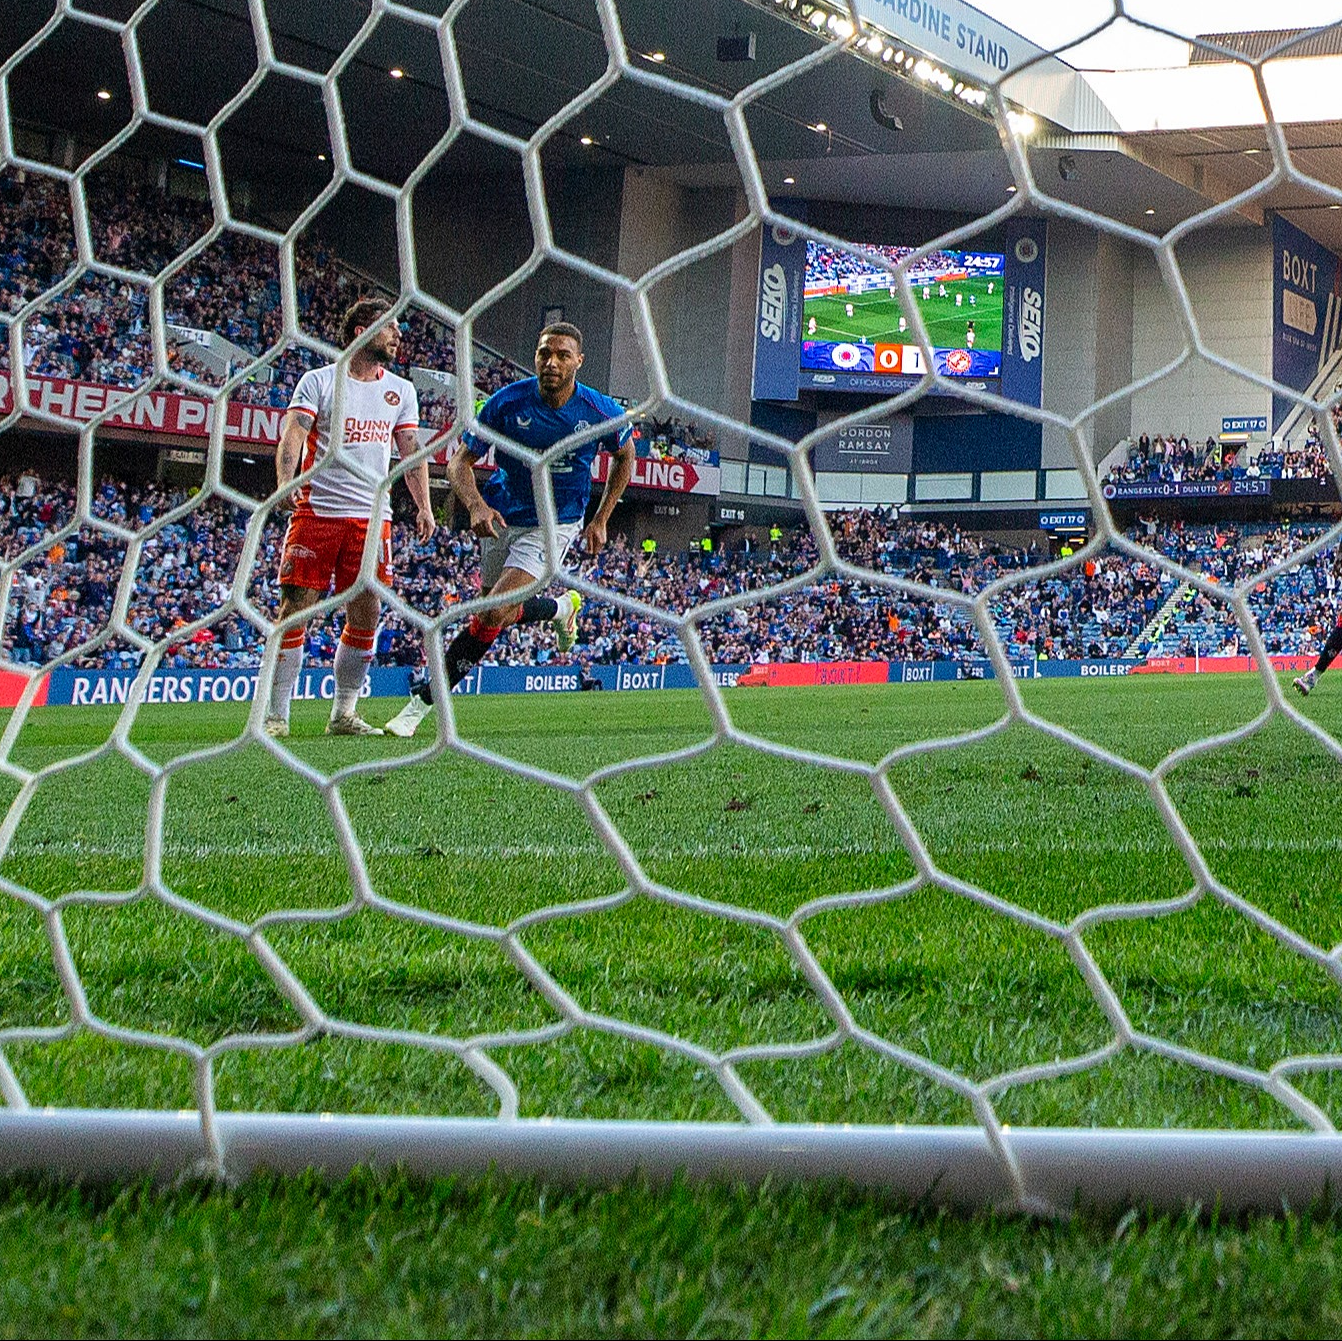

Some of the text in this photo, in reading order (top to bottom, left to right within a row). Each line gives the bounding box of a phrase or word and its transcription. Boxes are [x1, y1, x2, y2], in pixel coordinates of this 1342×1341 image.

[956, 22, 1009, 72] STAND
[963, 255, 1000, 268] 24:57
[1283, 249, 1318, 294] BOXT
[760, 263, 787, 343] SEKO
[1021, 286, 1042, 362] SEKO
[879, 349, 899, 369] 0
[344, 417, 391, 431] QUINN
[840, 428, 892, 438] GORDON
[838, 440, 891, 450] RAMSAY
[1118, 486, 1153, 495] RANGERS
[1201, 485, 1217, 493] UTD
[1234, 481, 1266, 493] 24:57
[721, 508, 736, 519] EXIT
[1049, 515, 1066, 525] EXIT
[906, 667, 931, 681] BOXT
[956, 667, 984, 680] BERS
[1013, 665, 1030, 678] OXT
[1080, 664, 1132, 676] BOILERS
[525, 674, 578, 691] BOILERS
[623, 672, 660, 689] BOXT
[198, 675, 313, 702] FOOTLL
[319, 674, 371, 700] CB
